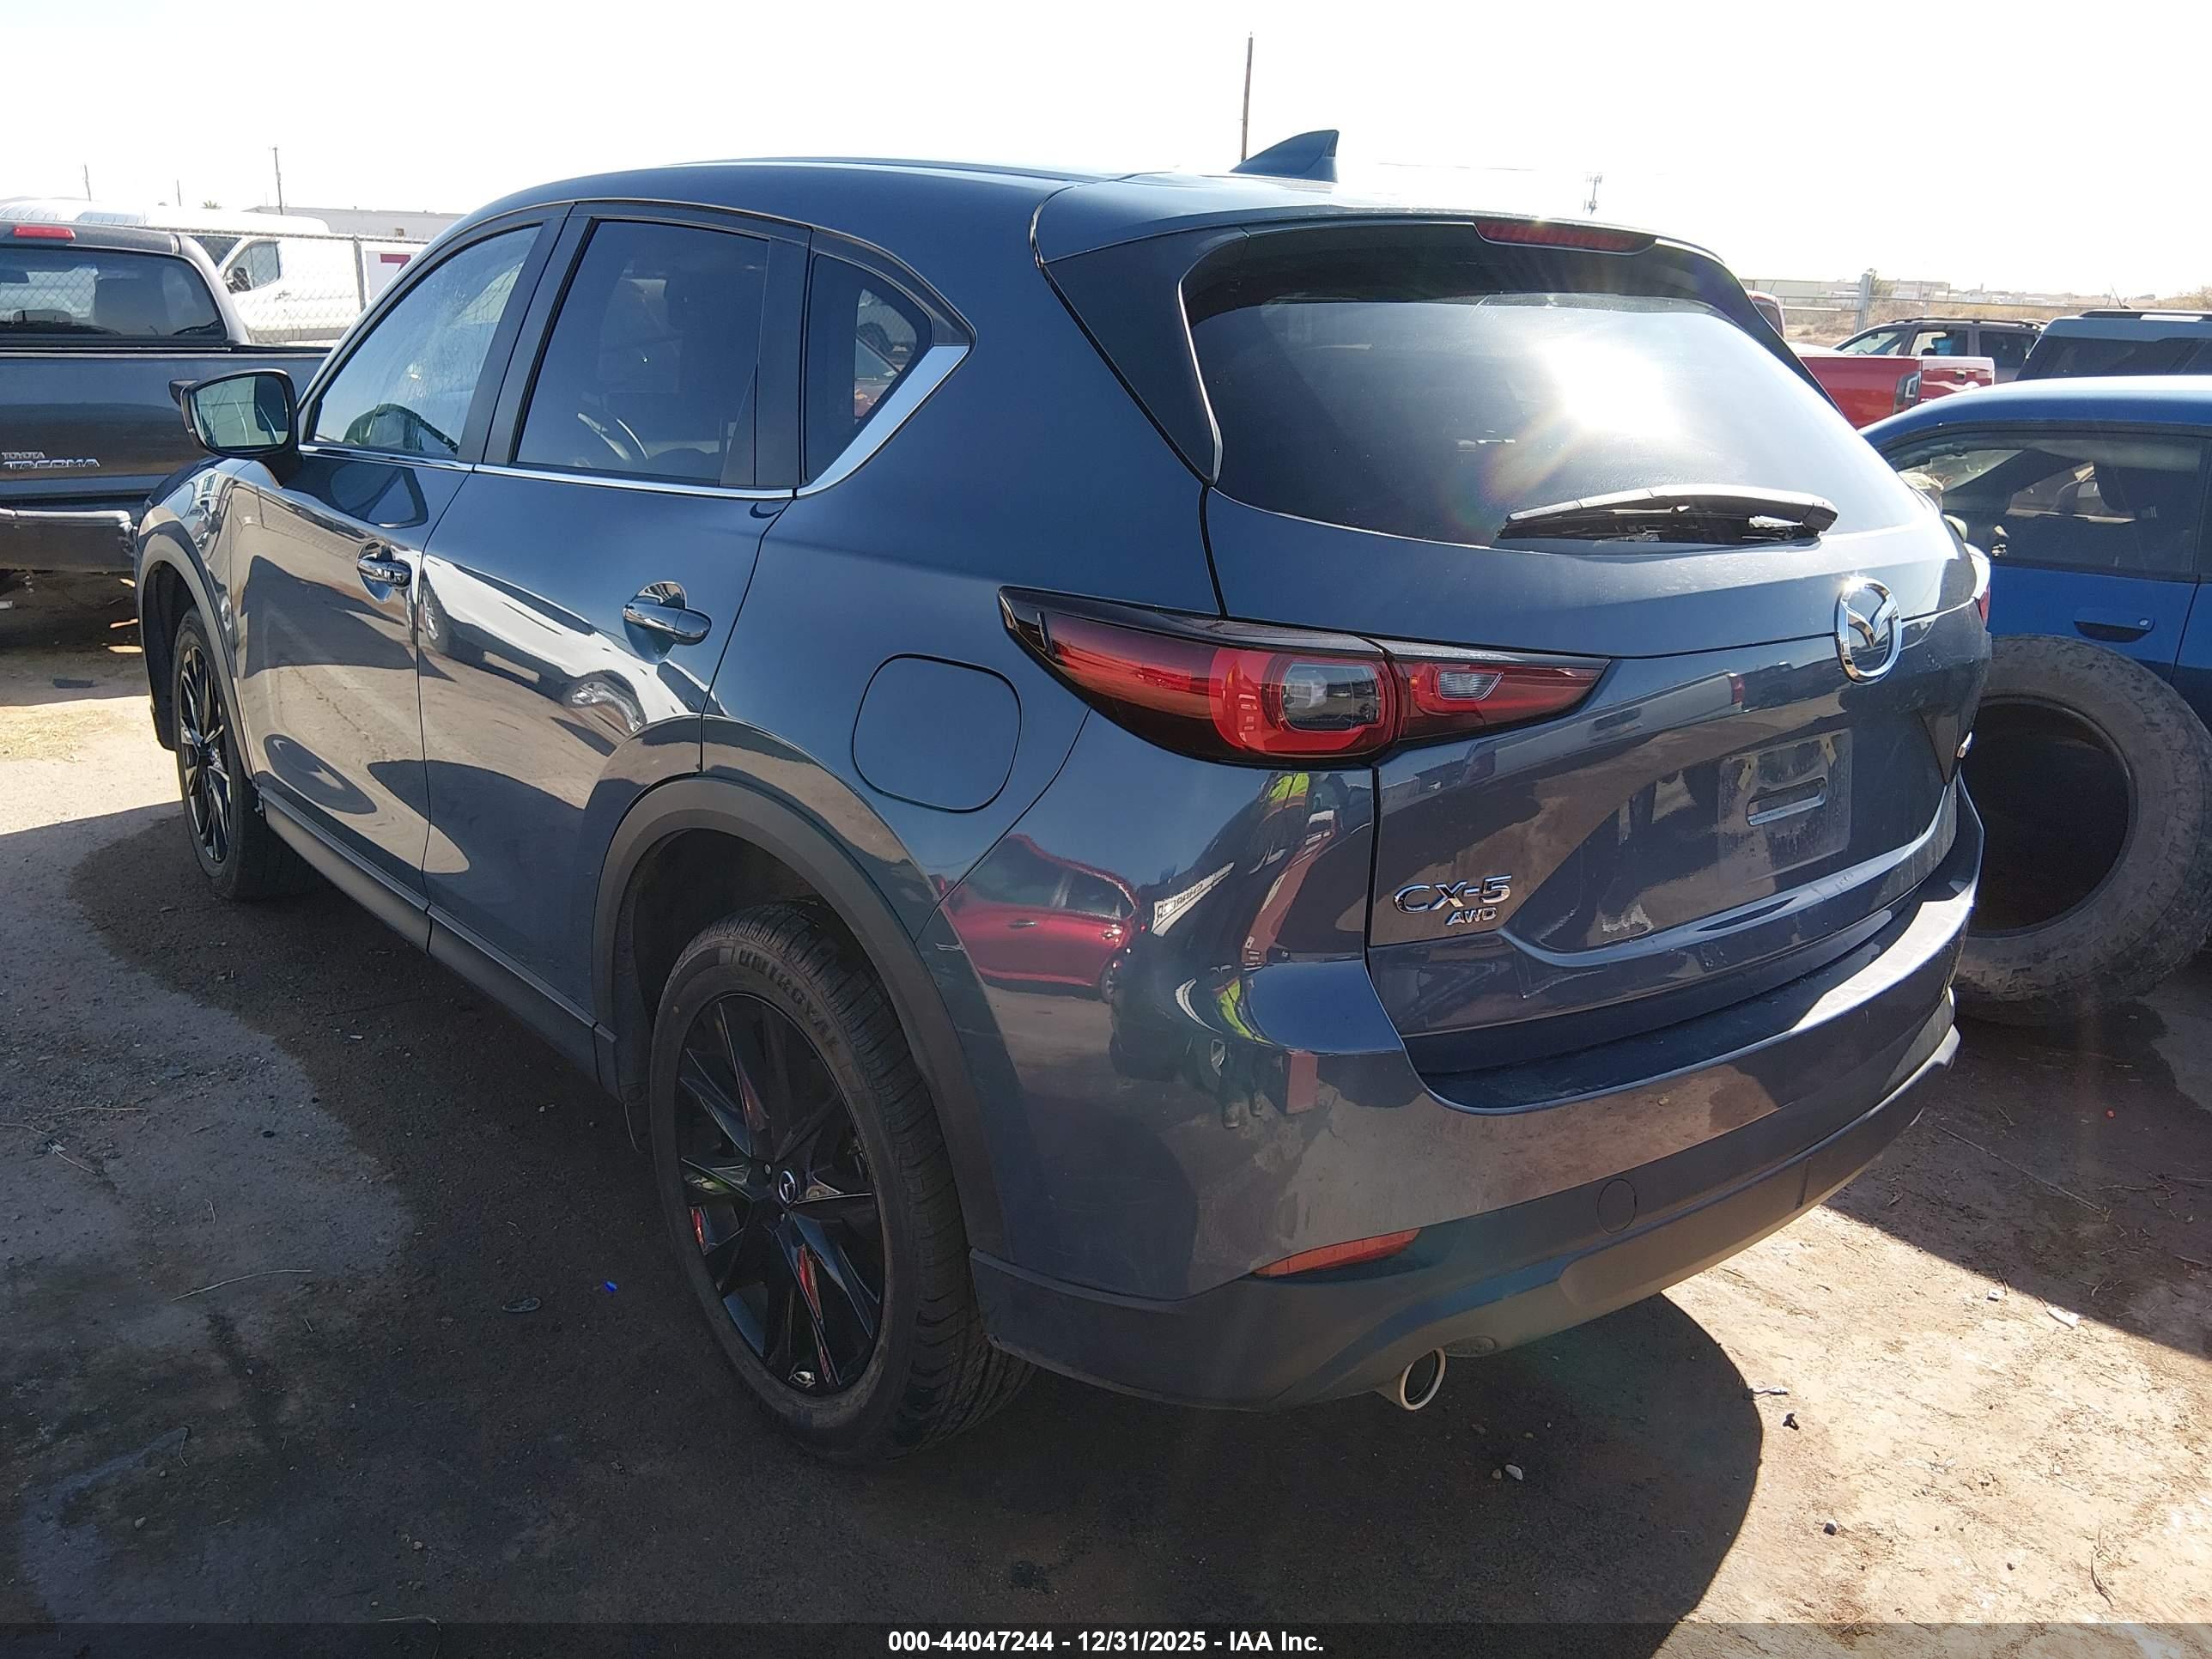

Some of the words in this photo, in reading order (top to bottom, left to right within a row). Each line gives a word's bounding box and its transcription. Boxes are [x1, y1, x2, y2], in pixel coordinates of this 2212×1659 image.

[3, 459, 100, 469] TACOMA
[1394, 874, 1511, 914] CX-5
[1445, 906, 1497, 926] AWD
